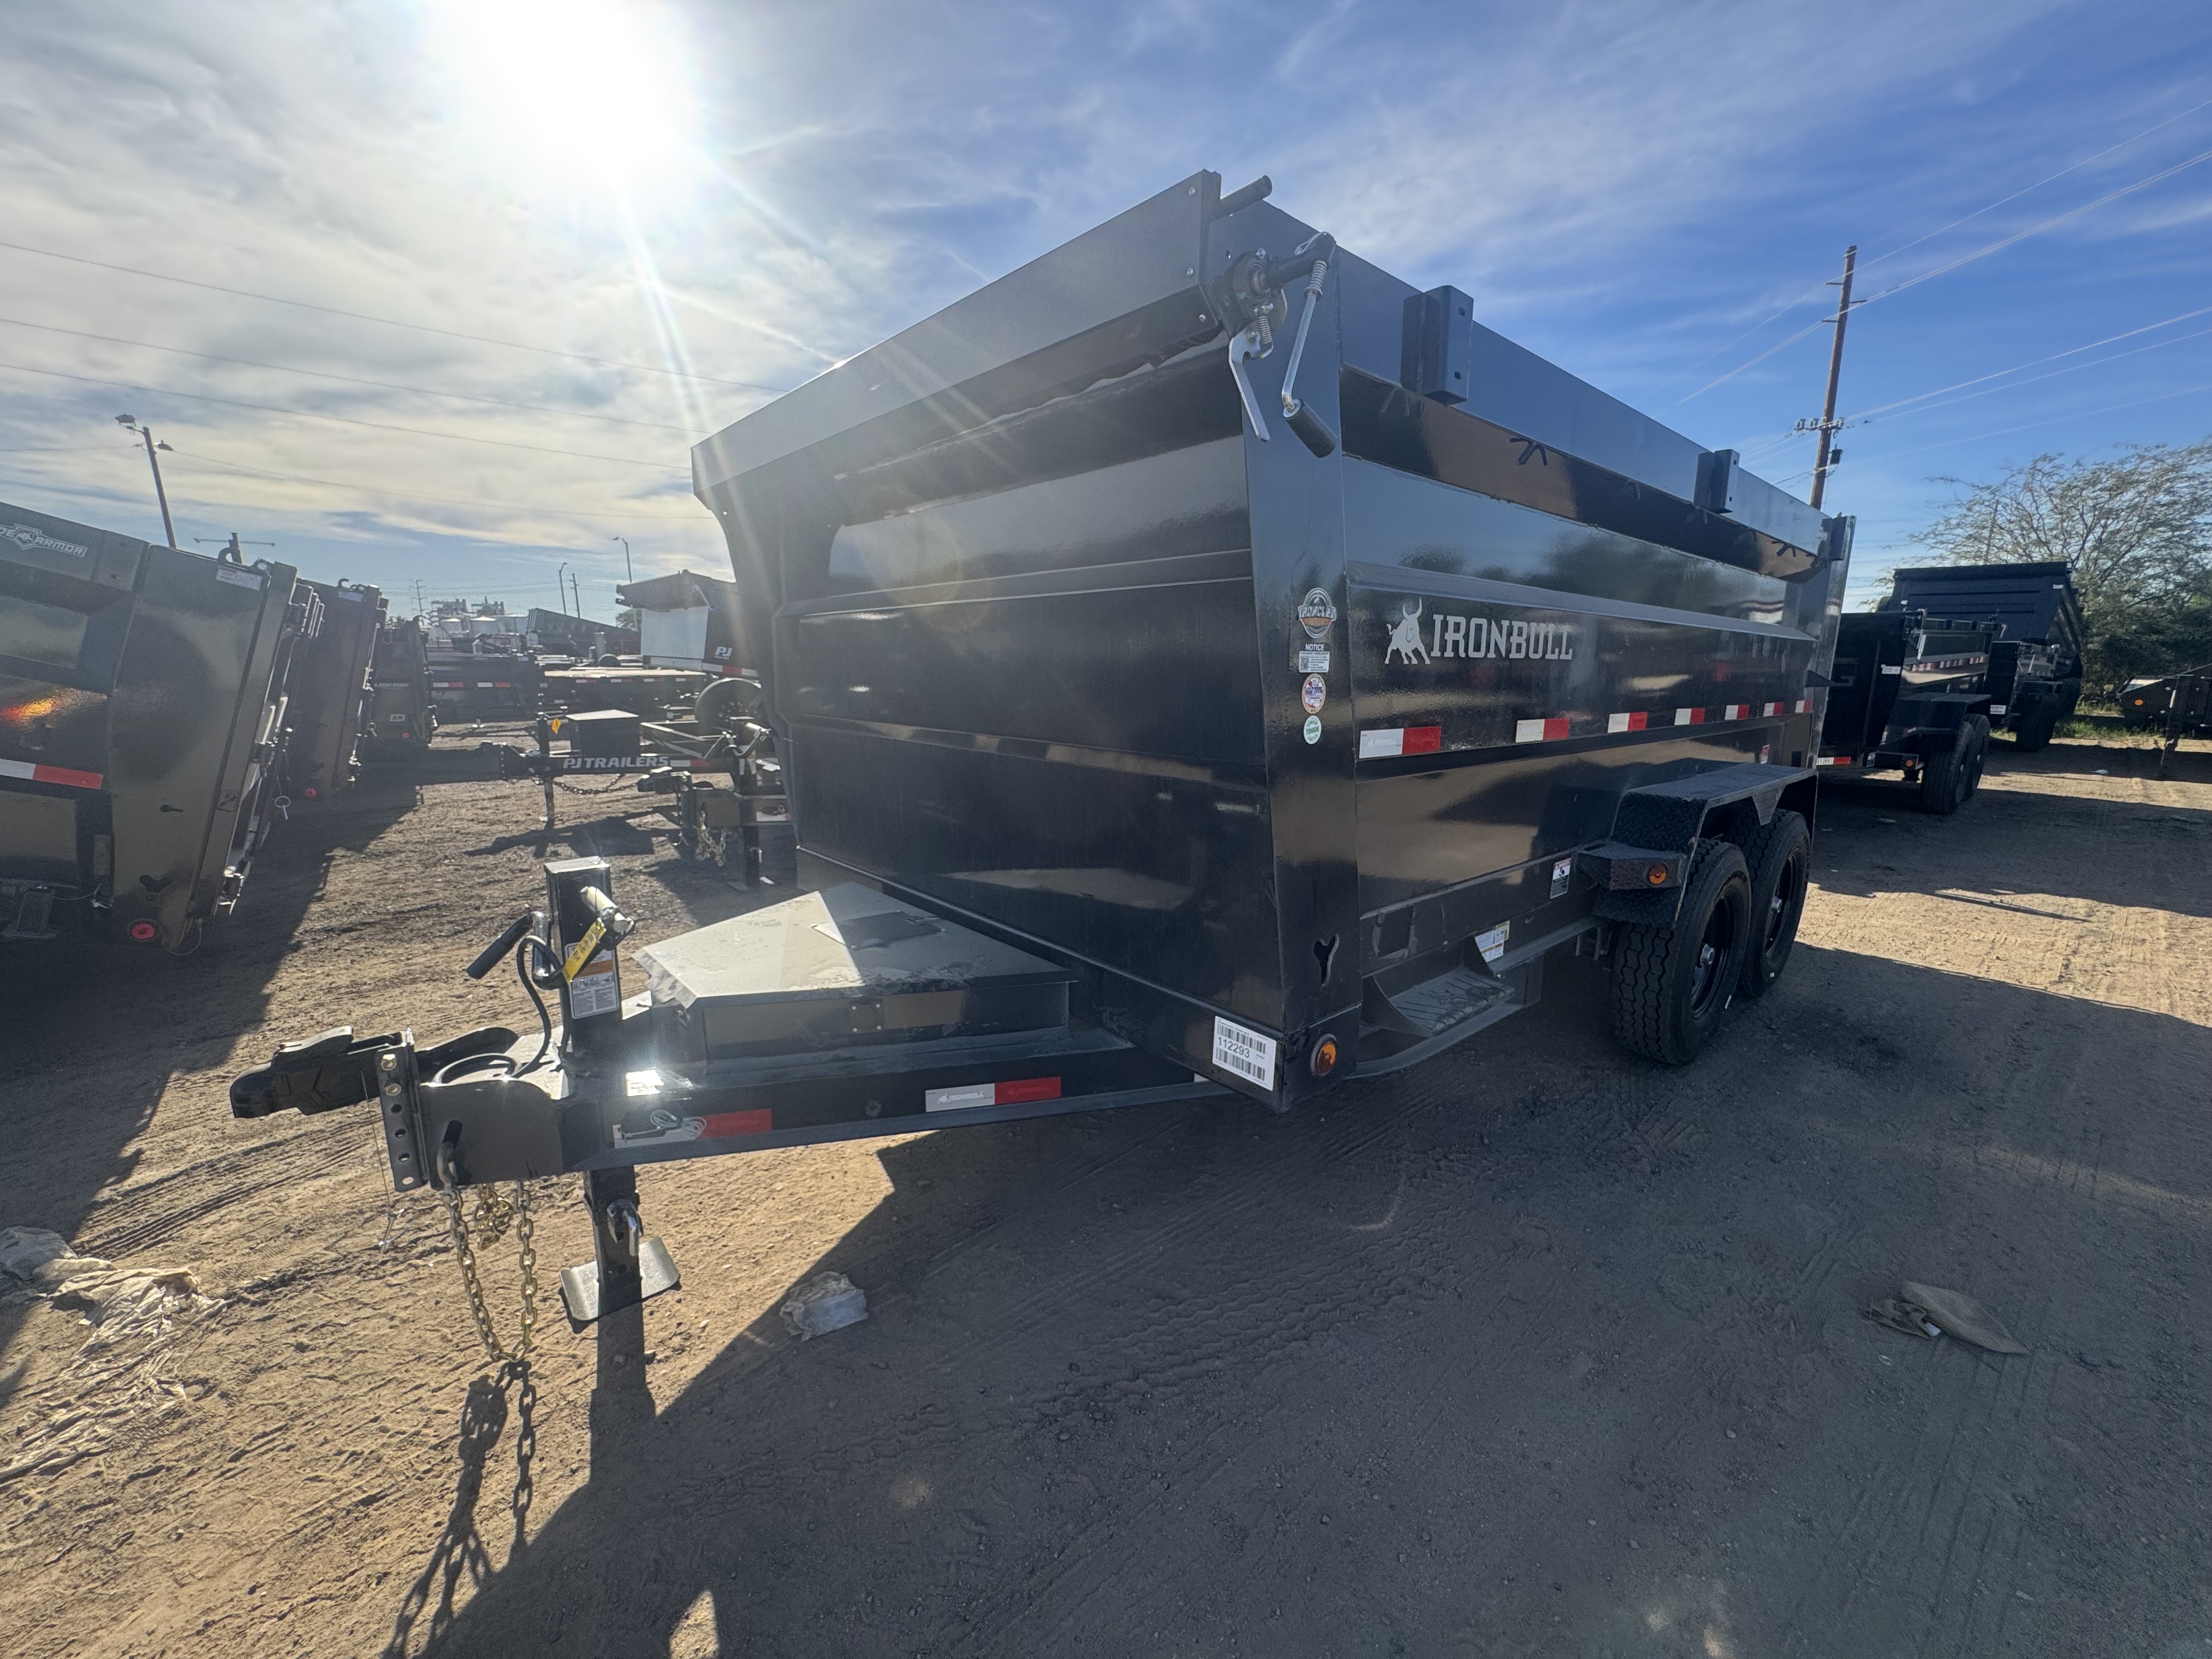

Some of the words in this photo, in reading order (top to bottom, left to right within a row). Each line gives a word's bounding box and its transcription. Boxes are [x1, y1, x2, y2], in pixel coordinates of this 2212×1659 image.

[35, 536, 84, 555] ARMOR
[1430, 613, 1573, 660] IRONBULL
[715, 646, 732, 657] PJ
[563, 758, 582, 768] PJ
[584, 756, 669, 768] TRAILERS
[1217, 1036, 1250, 1058] 112293
